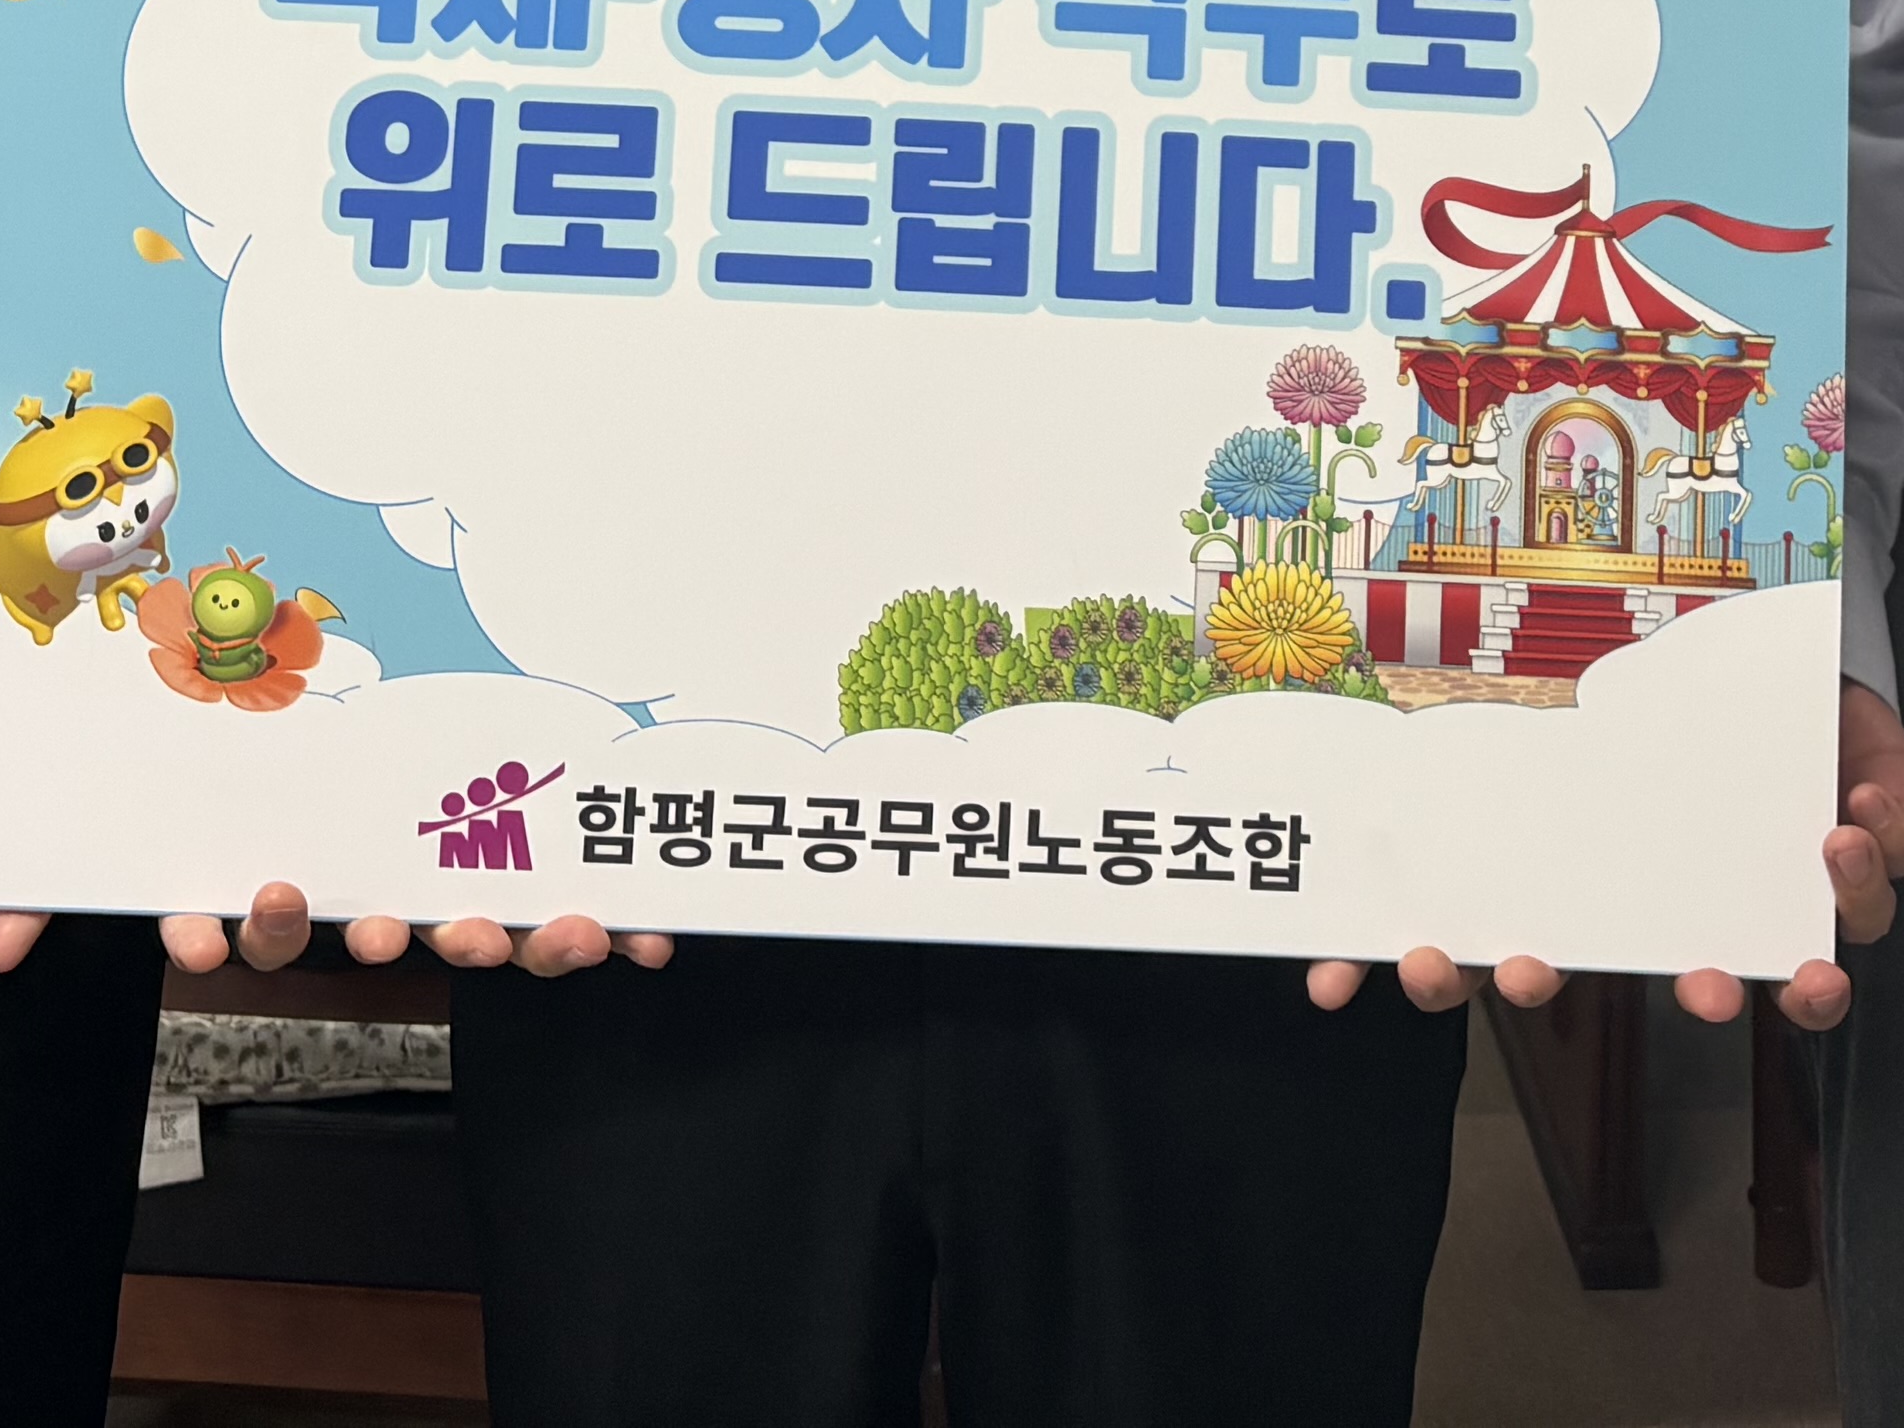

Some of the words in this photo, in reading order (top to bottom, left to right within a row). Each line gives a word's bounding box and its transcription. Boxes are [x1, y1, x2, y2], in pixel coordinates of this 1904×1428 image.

[336, 87, 664, 282] 위로
[711, 107, 1429, 324] 드립니다.
[574, 783, 1312, 893] 함평군공무원노동조합
